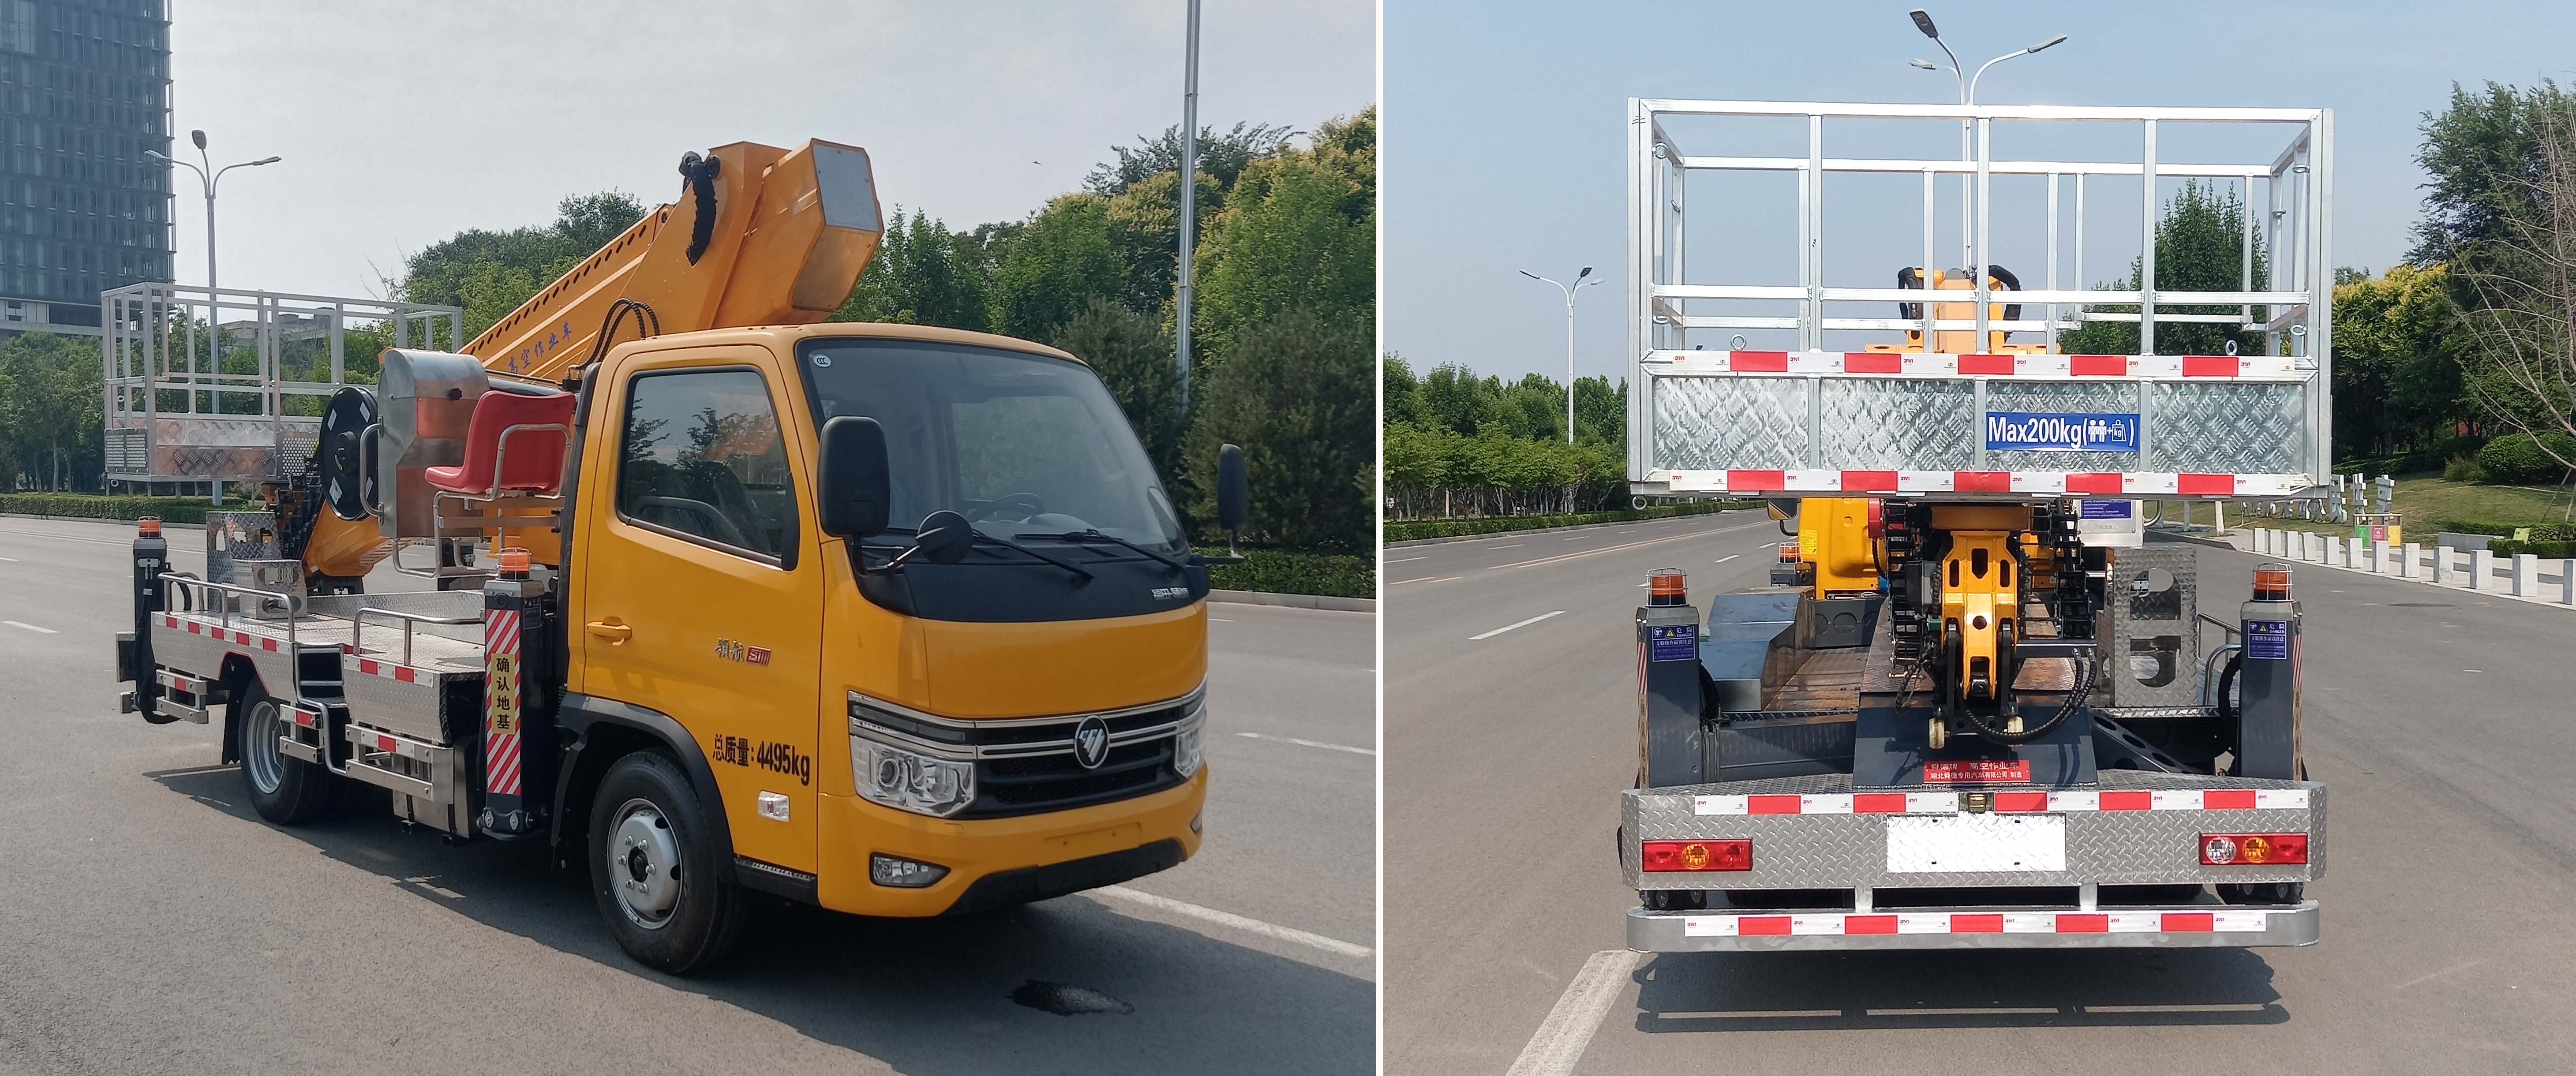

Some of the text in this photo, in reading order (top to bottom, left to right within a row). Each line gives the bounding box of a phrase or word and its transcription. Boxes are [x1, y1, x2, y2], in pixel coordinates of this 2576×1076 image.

[508, 321, 573, 374] 高空作业车
[496, 657, 510, 729] 确认地基
[1969, 762, 2019, 770] 高空作业车
